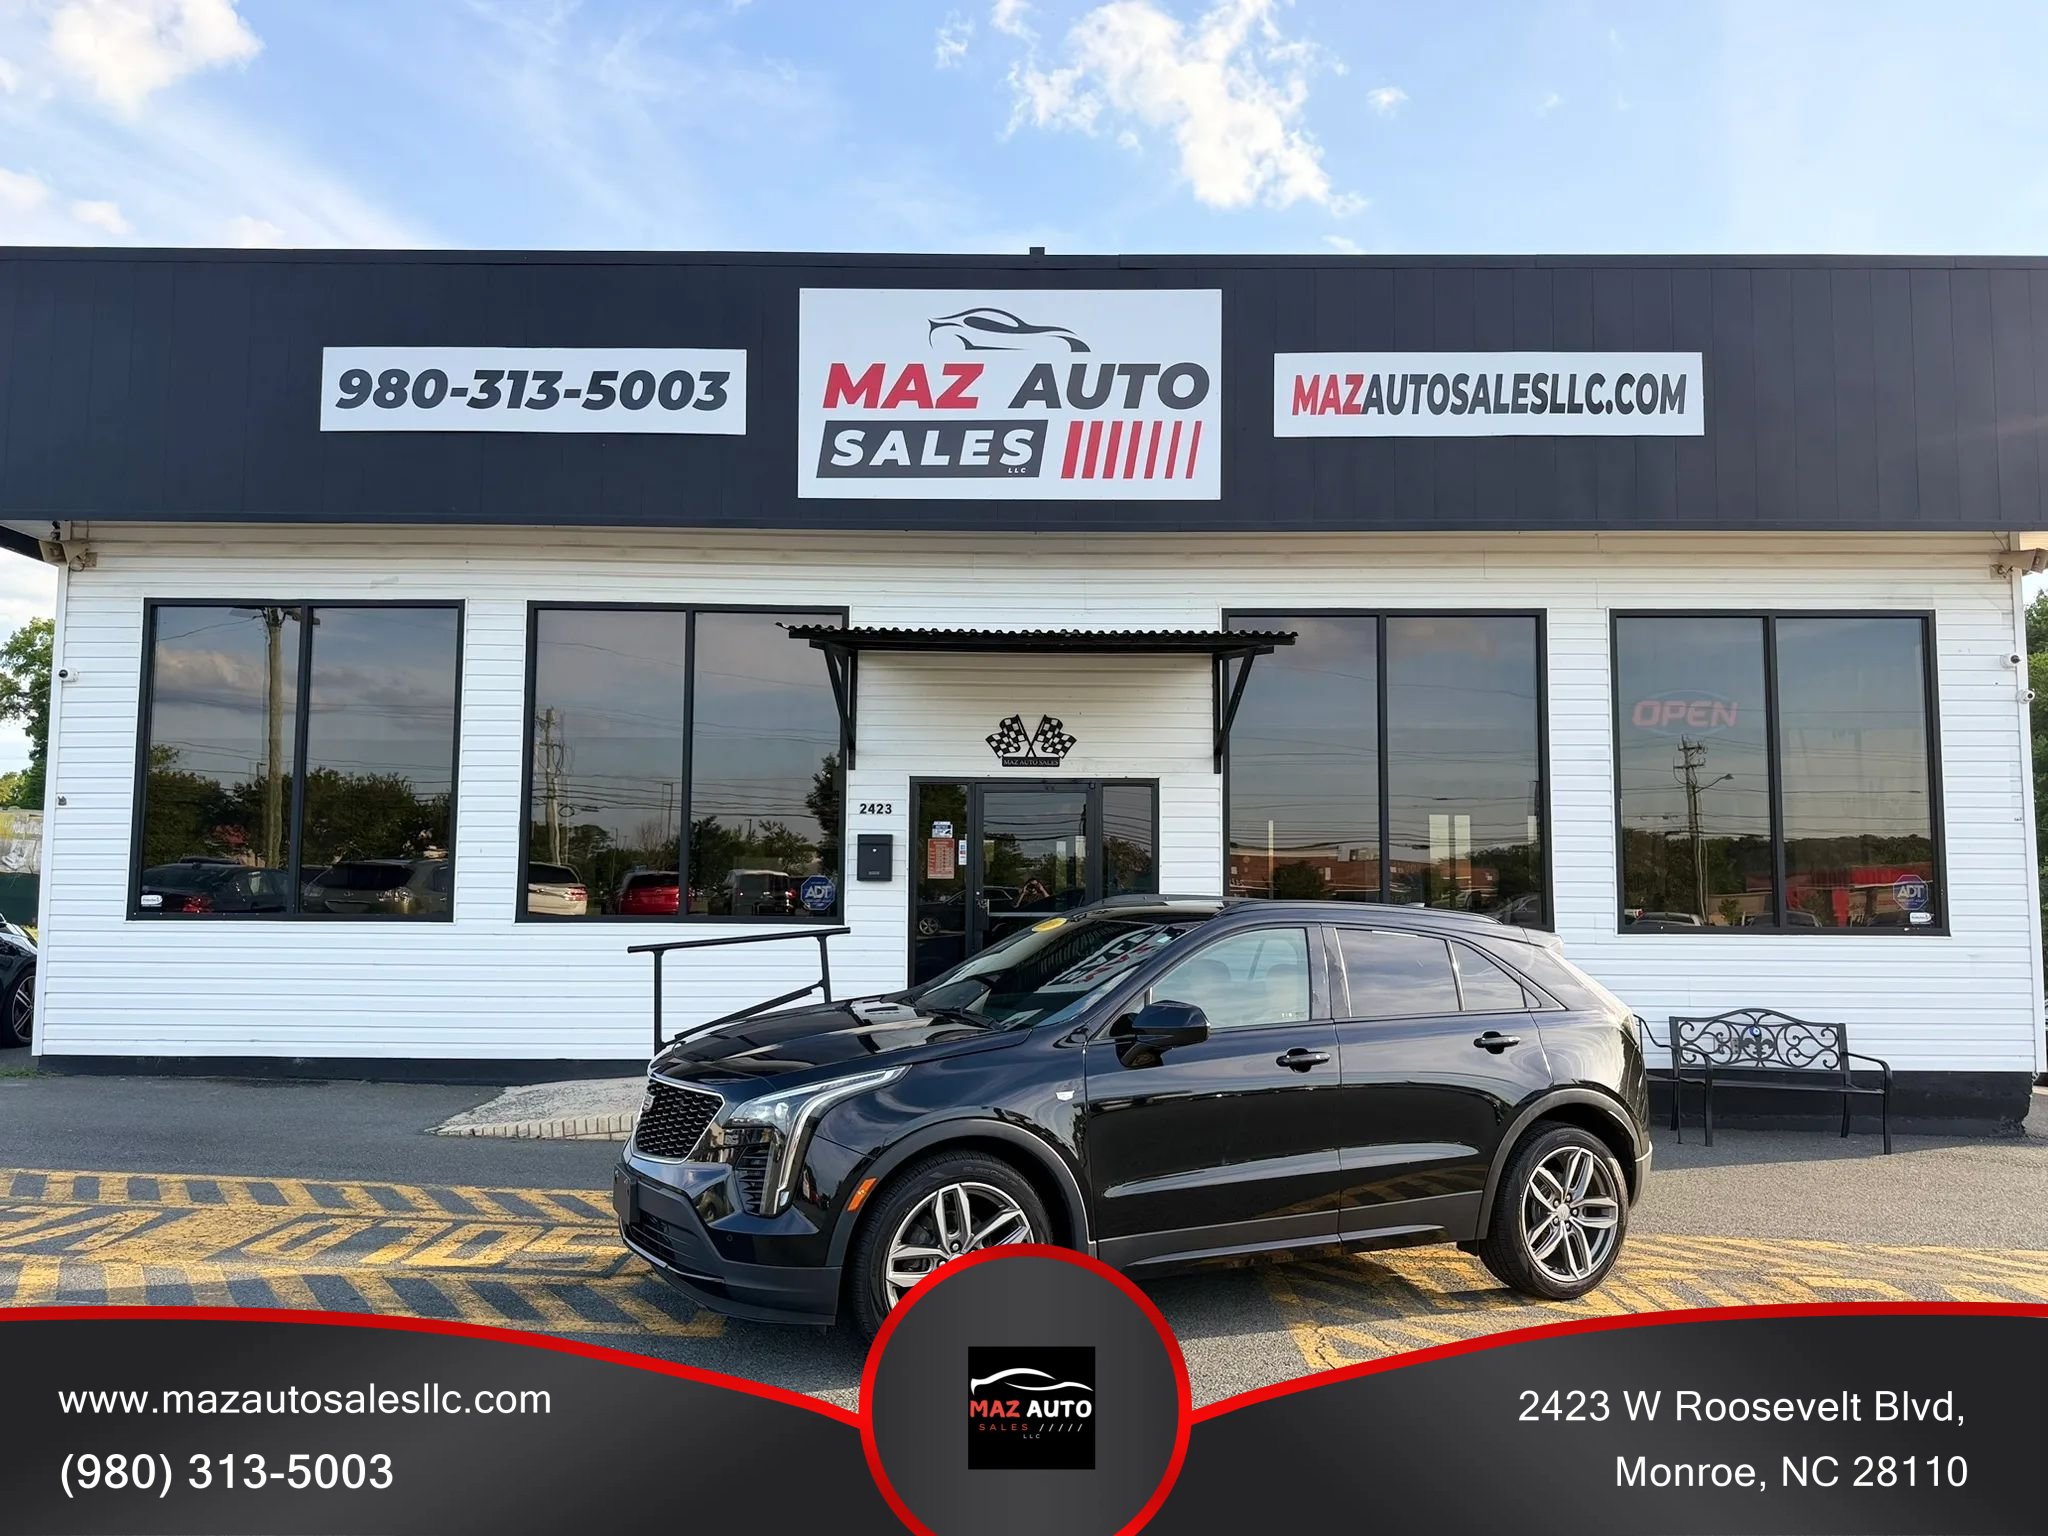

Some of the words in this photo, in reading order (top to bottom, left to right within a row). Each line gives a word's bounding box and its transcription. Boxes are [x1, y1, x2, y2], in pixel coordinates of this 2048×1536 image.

[335, 368, 731, 411] 980-313-5003
[822, 363, 984, 409] MAZ
[1007, 362, 1210, 410] AUTO
[1291, 372, 1687, 415] MAZAUTOSALESLLC.COM
[830, 429, 1034, 466] SALES
[1632, 700, 1738, 728] OPEN
[859, 803, 892, 815] 2423
[805, 885, 832, 899] ADT
[1897, 884, 1925, 898] ADT
